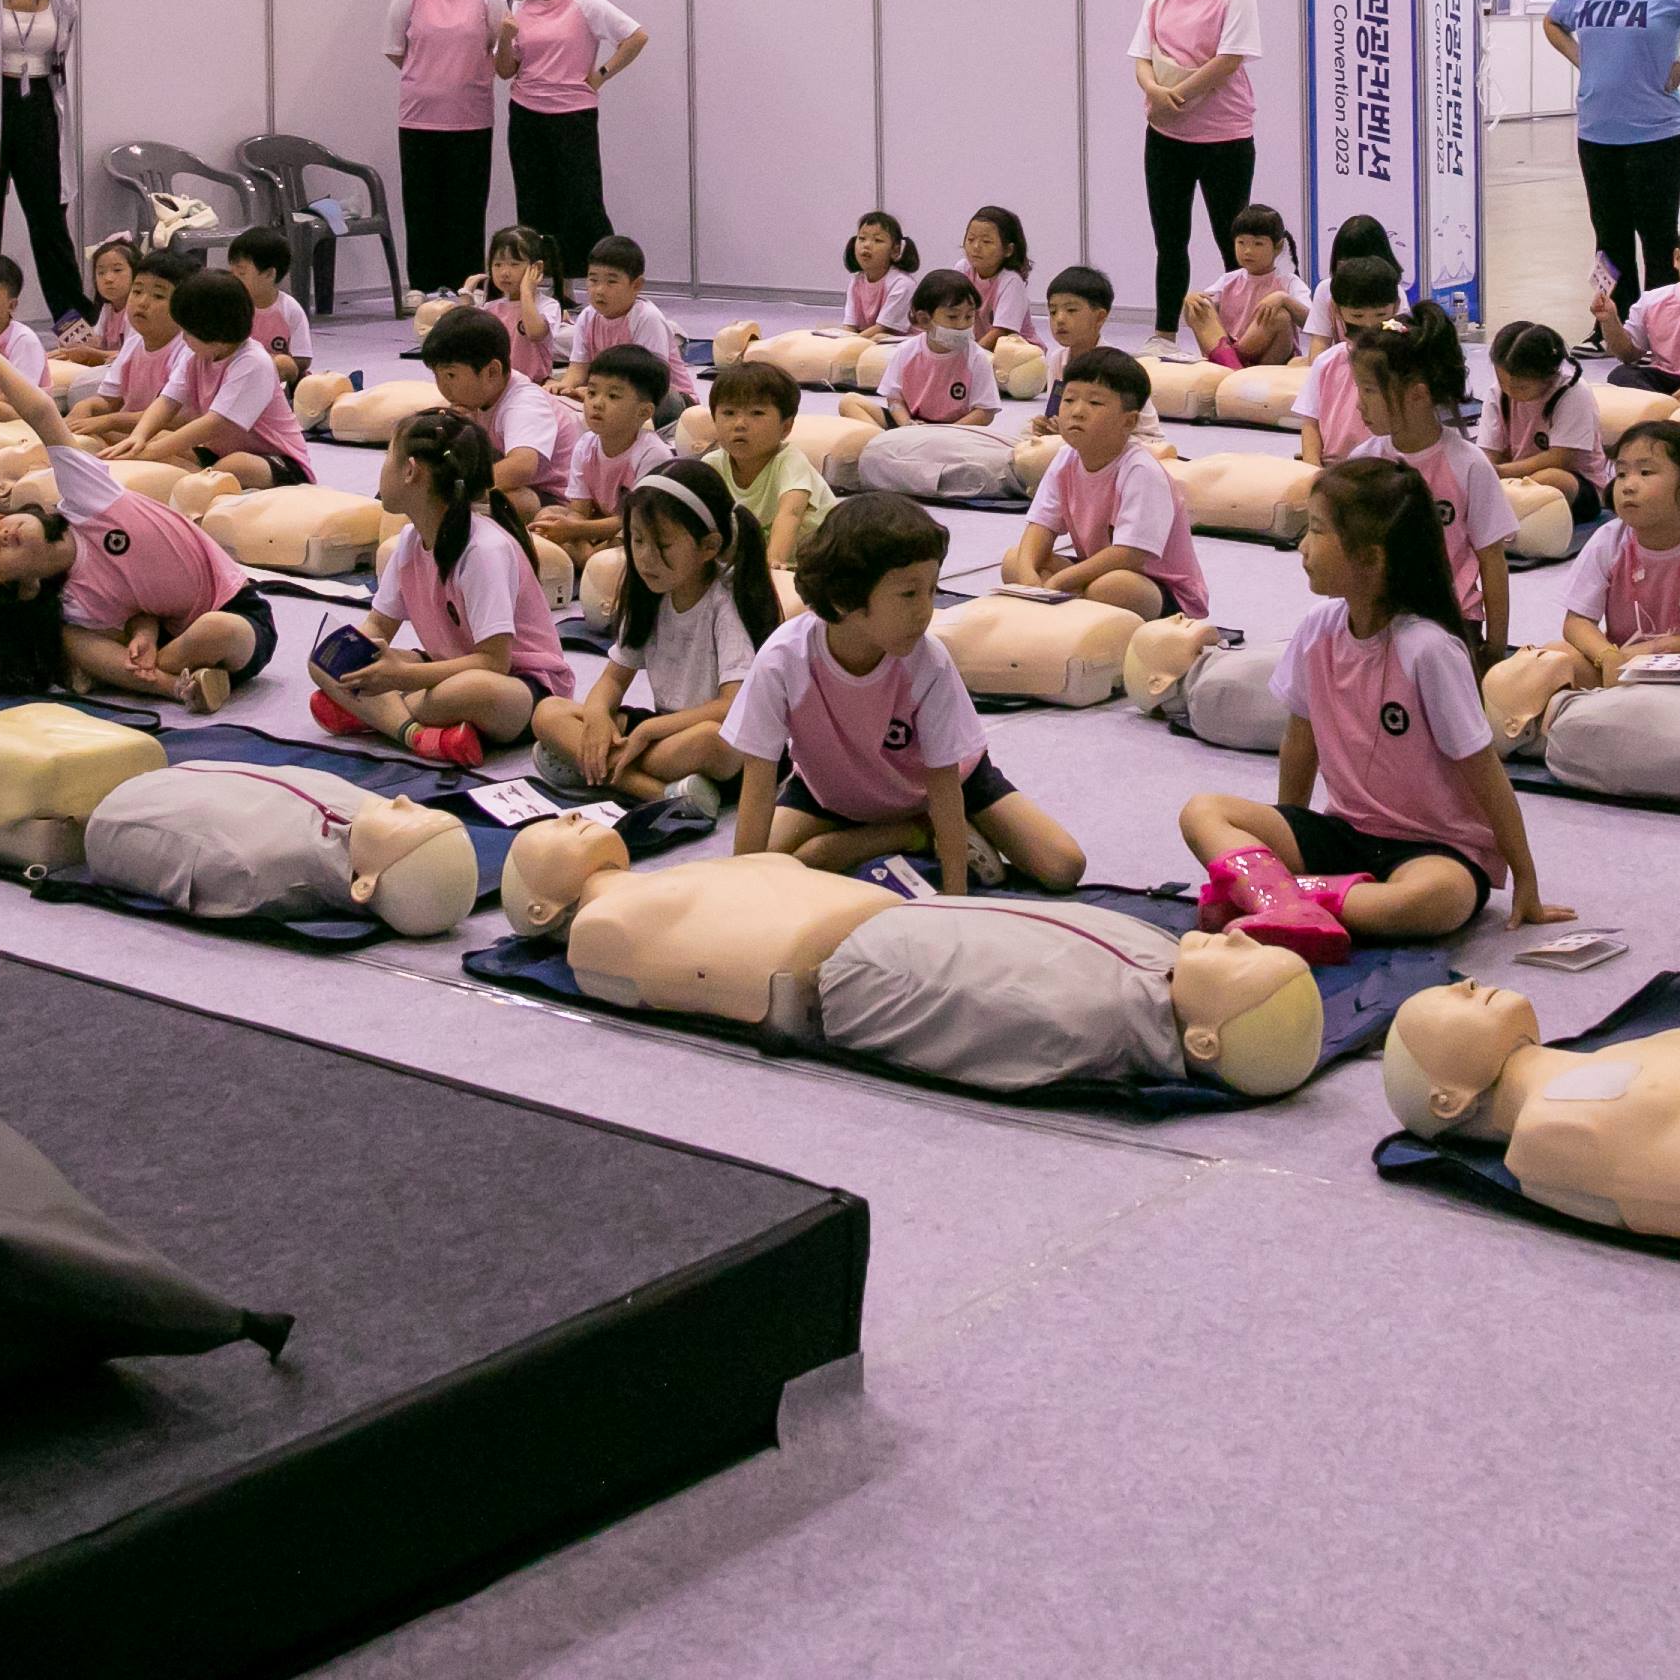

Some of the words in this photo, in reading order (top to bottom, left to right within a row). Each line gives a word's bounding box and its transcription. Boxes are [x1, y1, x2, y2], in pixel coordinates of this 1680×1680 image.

[1577, 0, 1649, 29] KIPA
[1333, 4, 1349, 122] Convention
[1335, 127, 1350, 176] 2023
